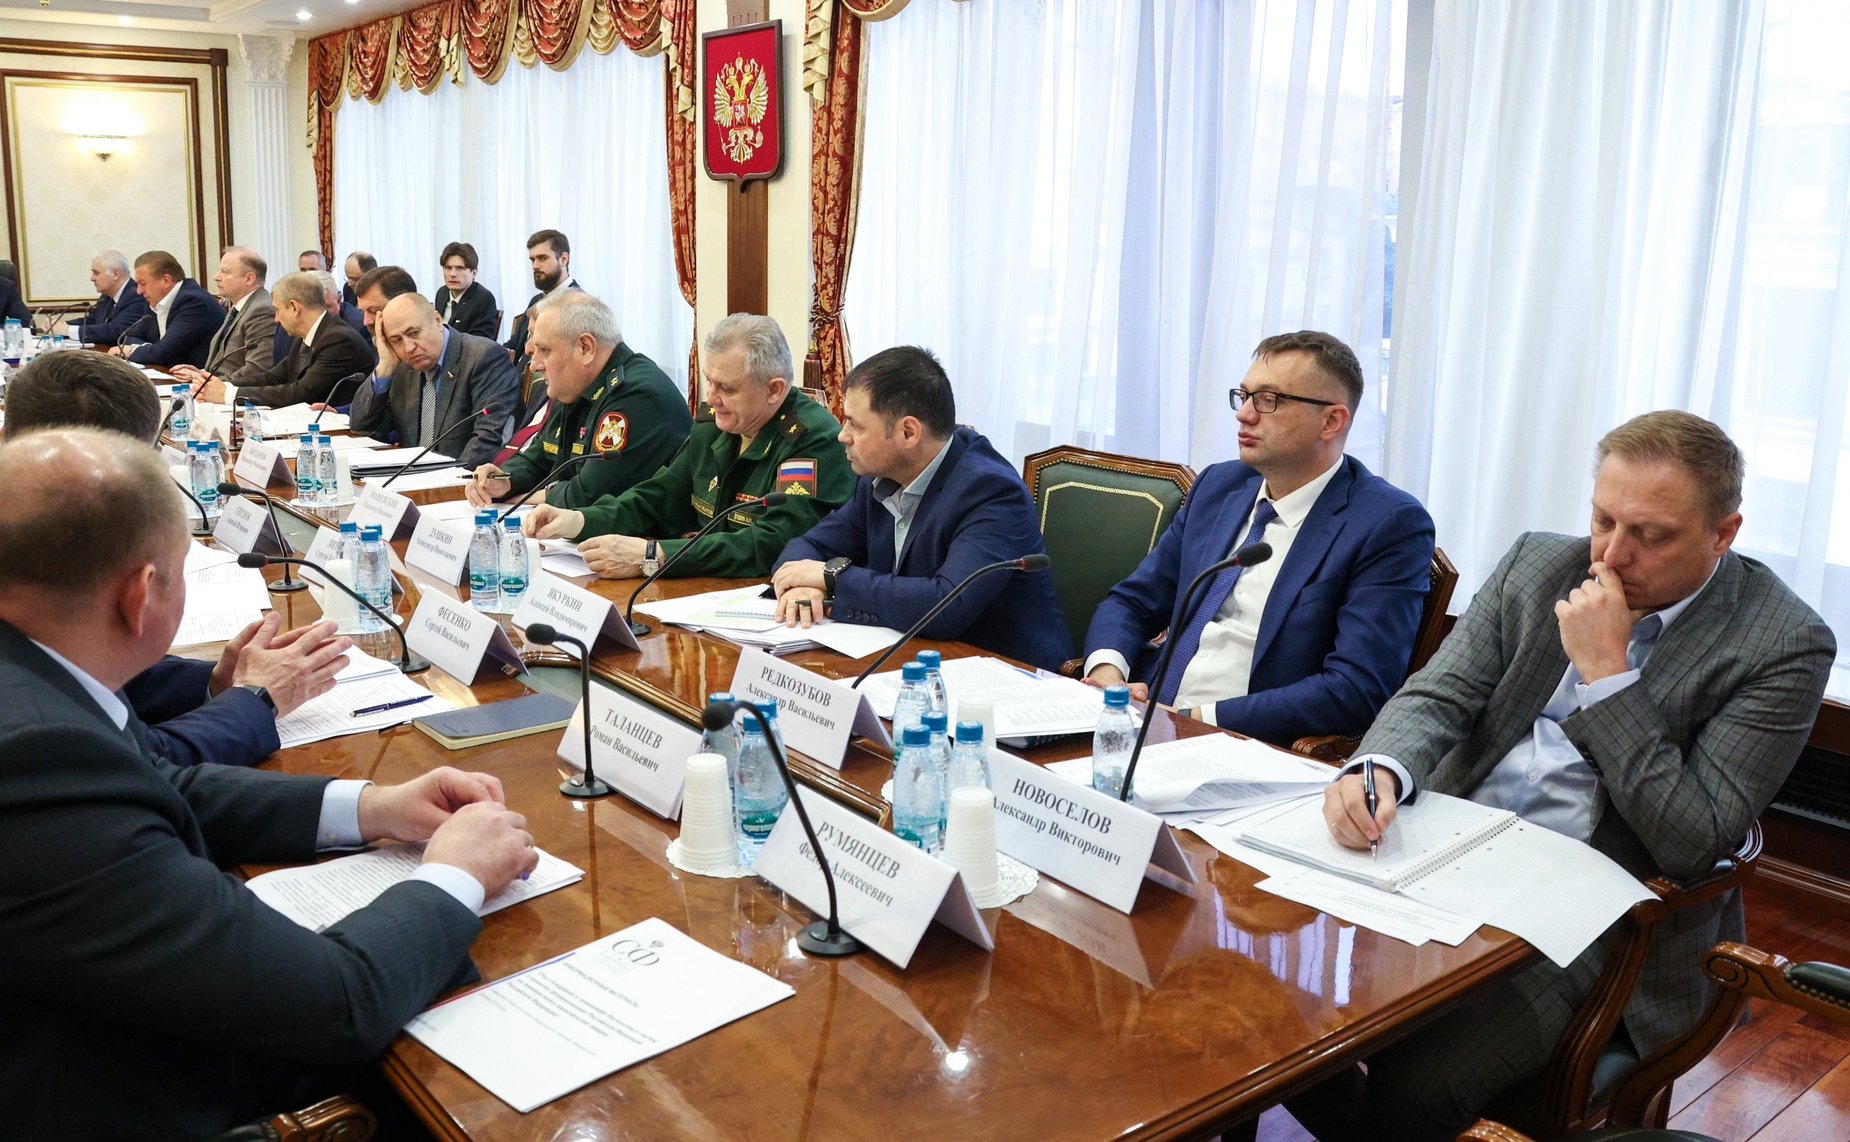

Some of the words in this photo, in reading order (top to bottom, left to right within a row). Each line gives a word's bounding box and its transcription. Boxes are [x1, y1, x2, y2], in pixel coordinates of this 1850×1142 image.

[437, 605, 472, 632] ФЕСЕНКО
[530, 598, 549, 615] Алексей
[549, 606, 588, 634] Владимирович
[546, 587, 583, 612] ЯКУРКИН
[424, 617, 442, 637] Сергей
[440, 626, 470, 652] Васильевич
[746, 682, 786, 711] Александр
[787, 699, 836, 731] Васильевич
[760, 665, 832, 708] РЕДКОЗУБОВ
[589, 725, 614, 750] Роман
[612, 736, 660, 774] Васильевич
[604, 708, 664, 750] ТАЛАНЦЕВ
[1012, 777, 1113, 836] НОВОСЕЛОВ
[815, 821, 901, 880] РУМЯНЦЕВ
[992, 795, 1047, 838] Александр
[1048, 819, 1122, 867] Викторович
[827, 857, 895, 909] Алексеевич
